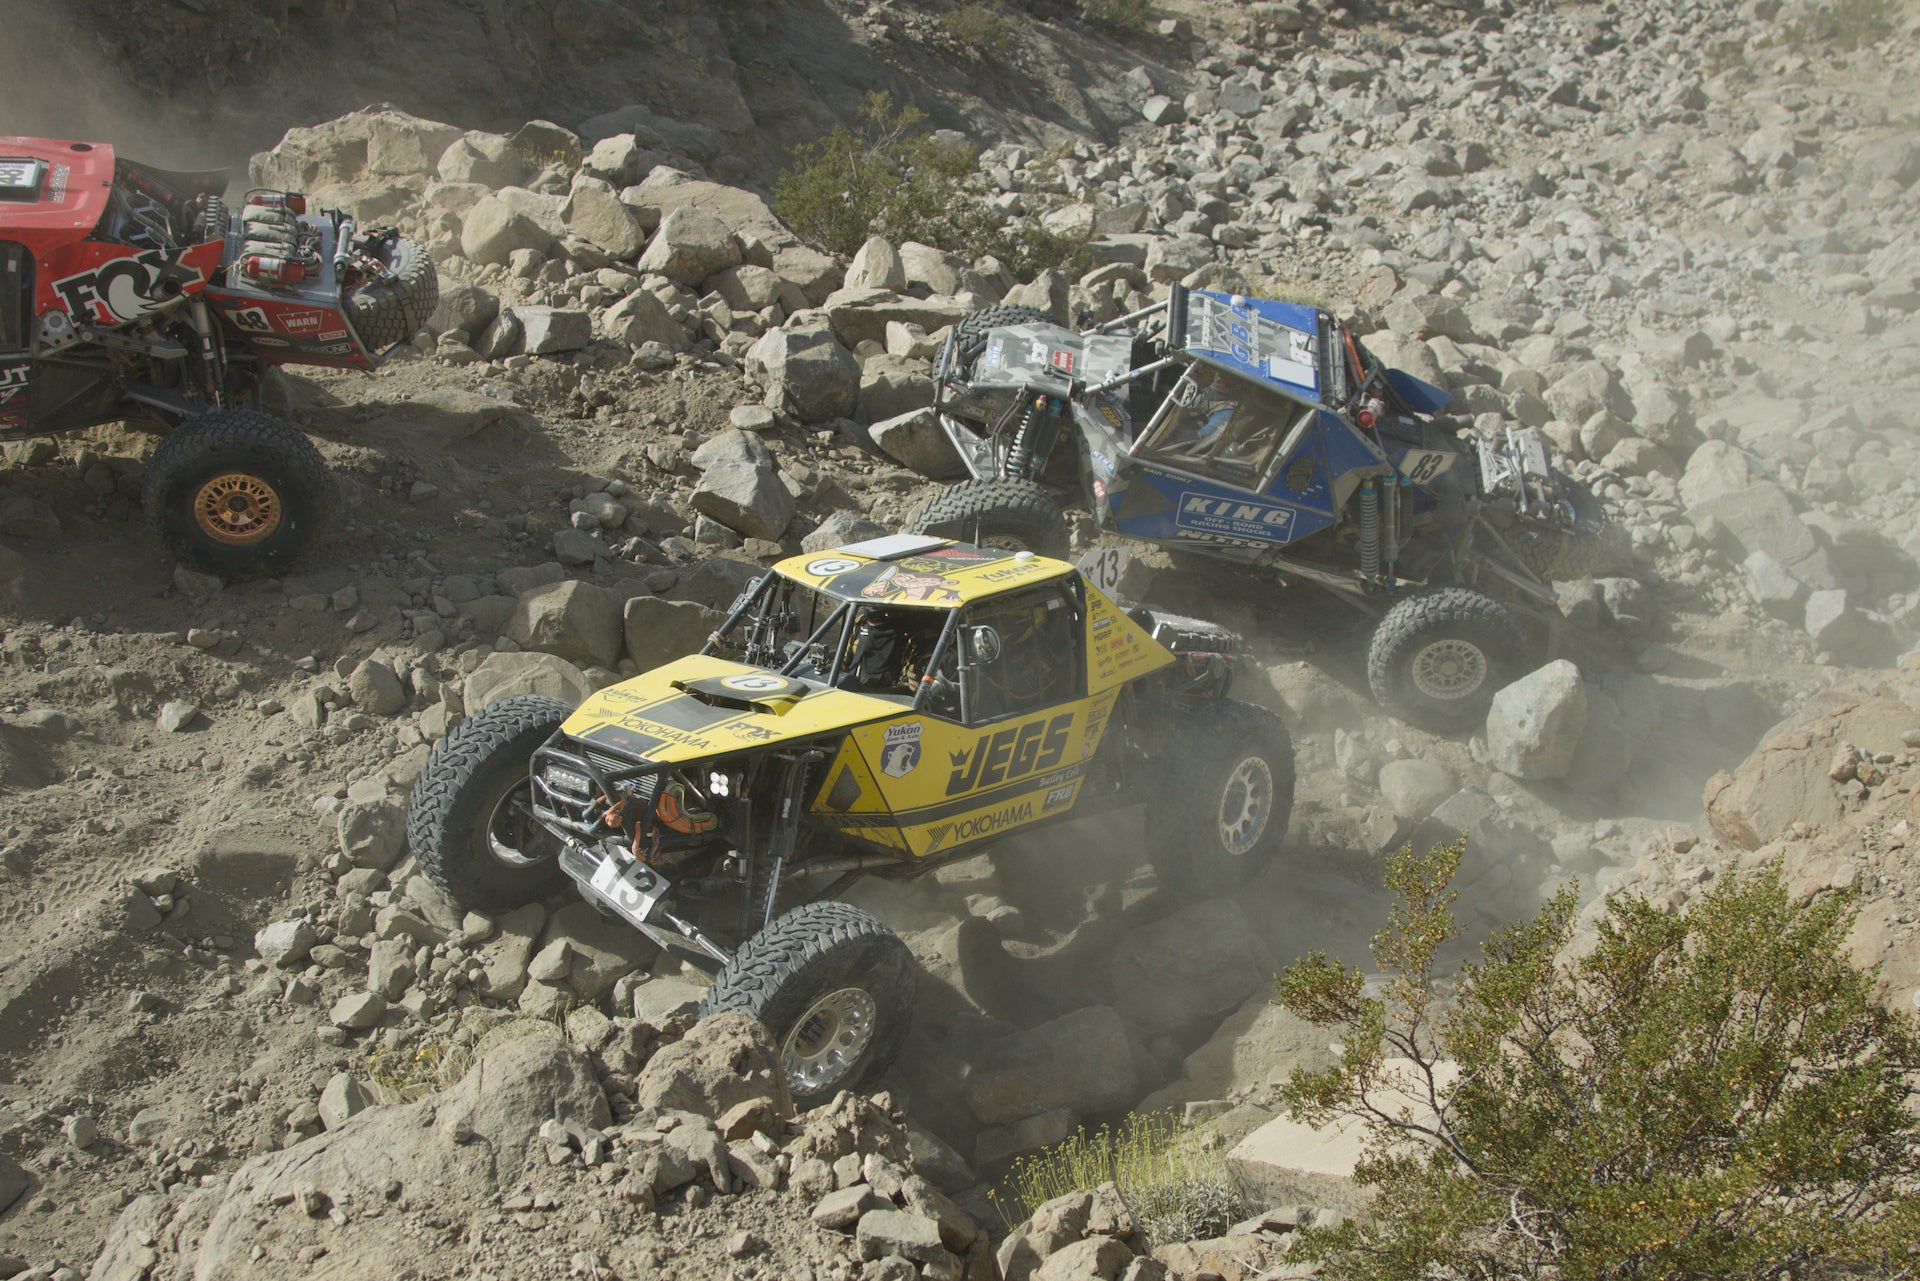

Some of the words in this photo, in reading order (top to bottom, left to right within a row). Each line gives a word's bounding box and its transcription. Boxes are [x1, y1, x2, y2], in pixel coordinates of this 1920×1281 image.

[51, 247, 205, 327] FOX
[236, 311, 269, 330] 48
[286, 317, 318, 328] WARN
[1410, 454, 1444, 480] 83
[1183, 497, 1291, 525] KING
[1190, 520, 1231, 530] RACING
[1204, 516, 1224, 524] OFF
[1232, 520, 1264, 530] ROAD
[813, 560, 855, 573] 13
[974, 563, 1041, 581] Yukon
[731, 677, 778, 689] 13
[617, 716, 711, 749] YOKOHAMA
[725, 721, 783, 740] FOX
[888, 726, 921, 737] Yukon
[945, 712, 1076, 796] JEGS
[954, 802, 1033, 842] YOKOHAMA
